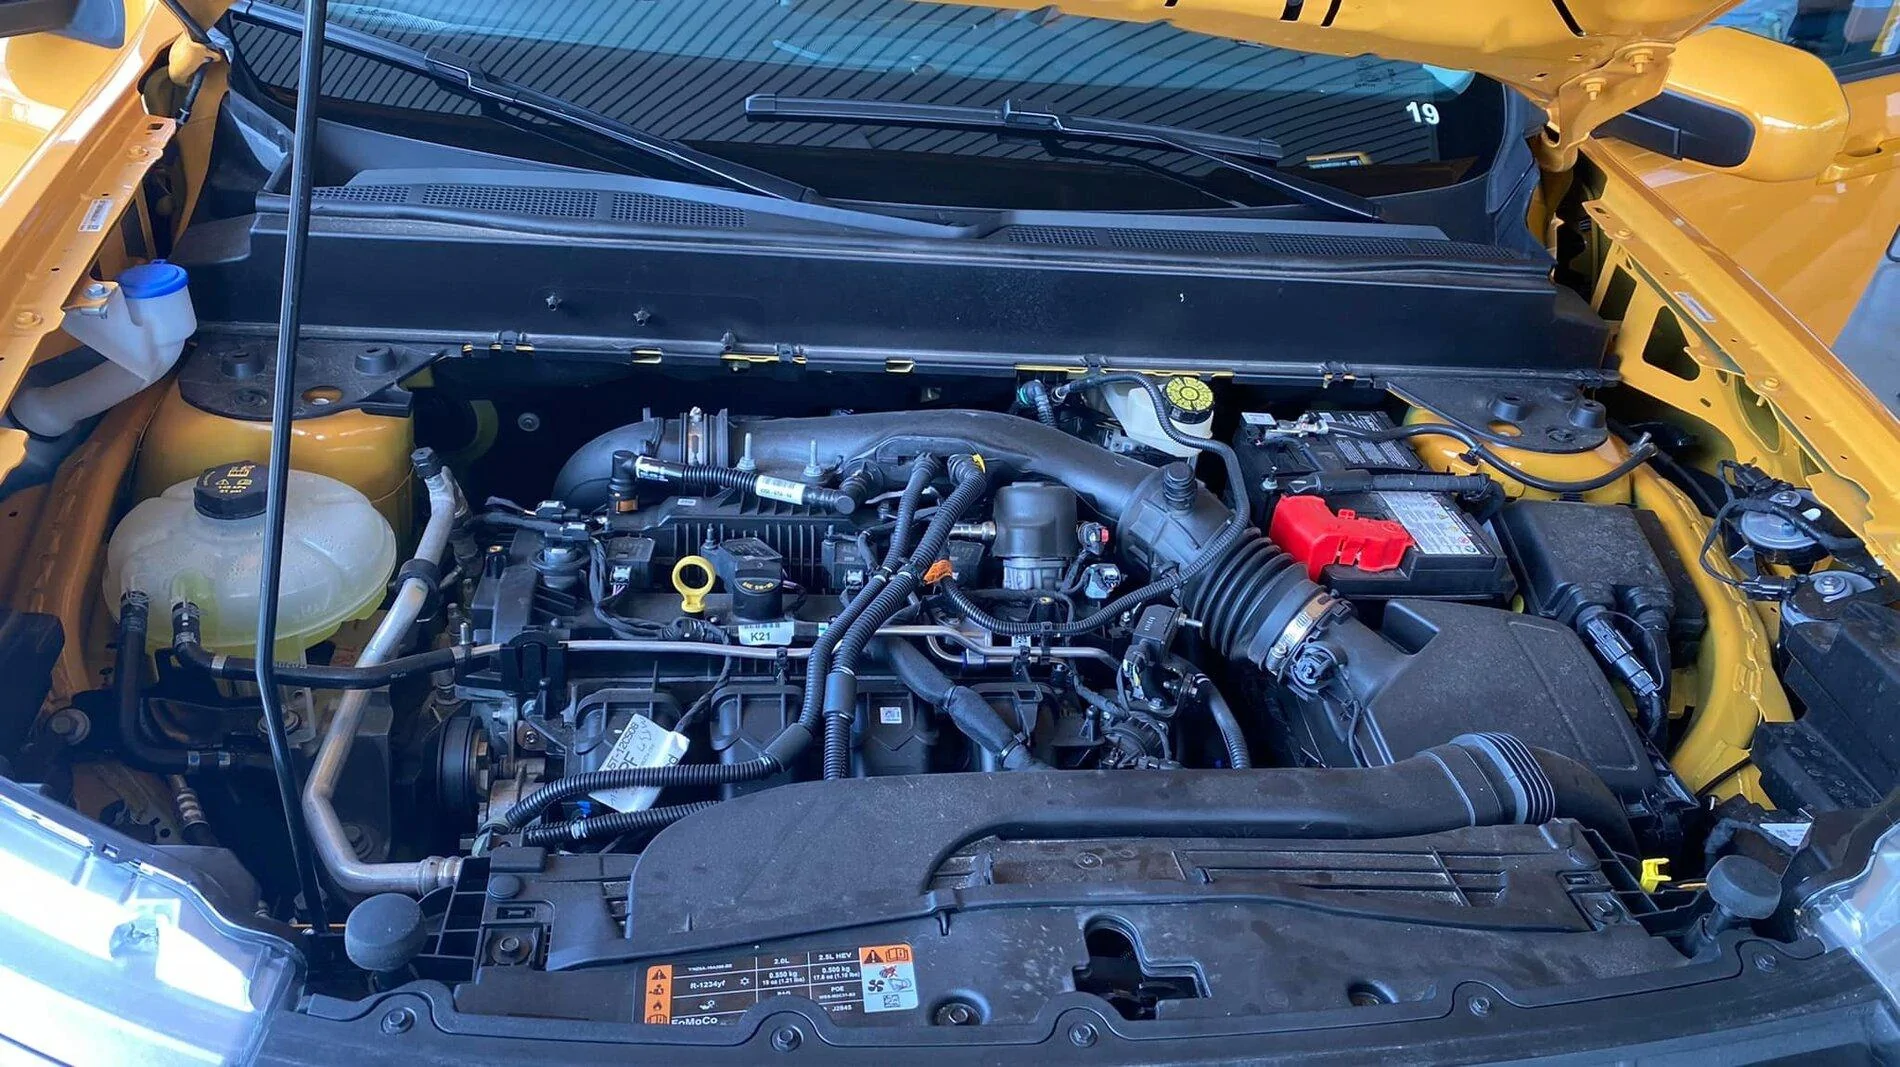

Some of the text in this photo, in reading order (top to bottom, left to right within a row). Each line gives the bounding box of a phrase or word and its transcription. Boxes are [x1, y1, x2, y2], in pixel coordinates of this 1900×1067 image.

[1406, 101, 1440, 125] 19
[751, 632, 771, 641] K21
[774, 957, 790, 965] 2.0L
[788, 970, 798, 978] kg
[690, 980, 726, 989] R-1234yf
